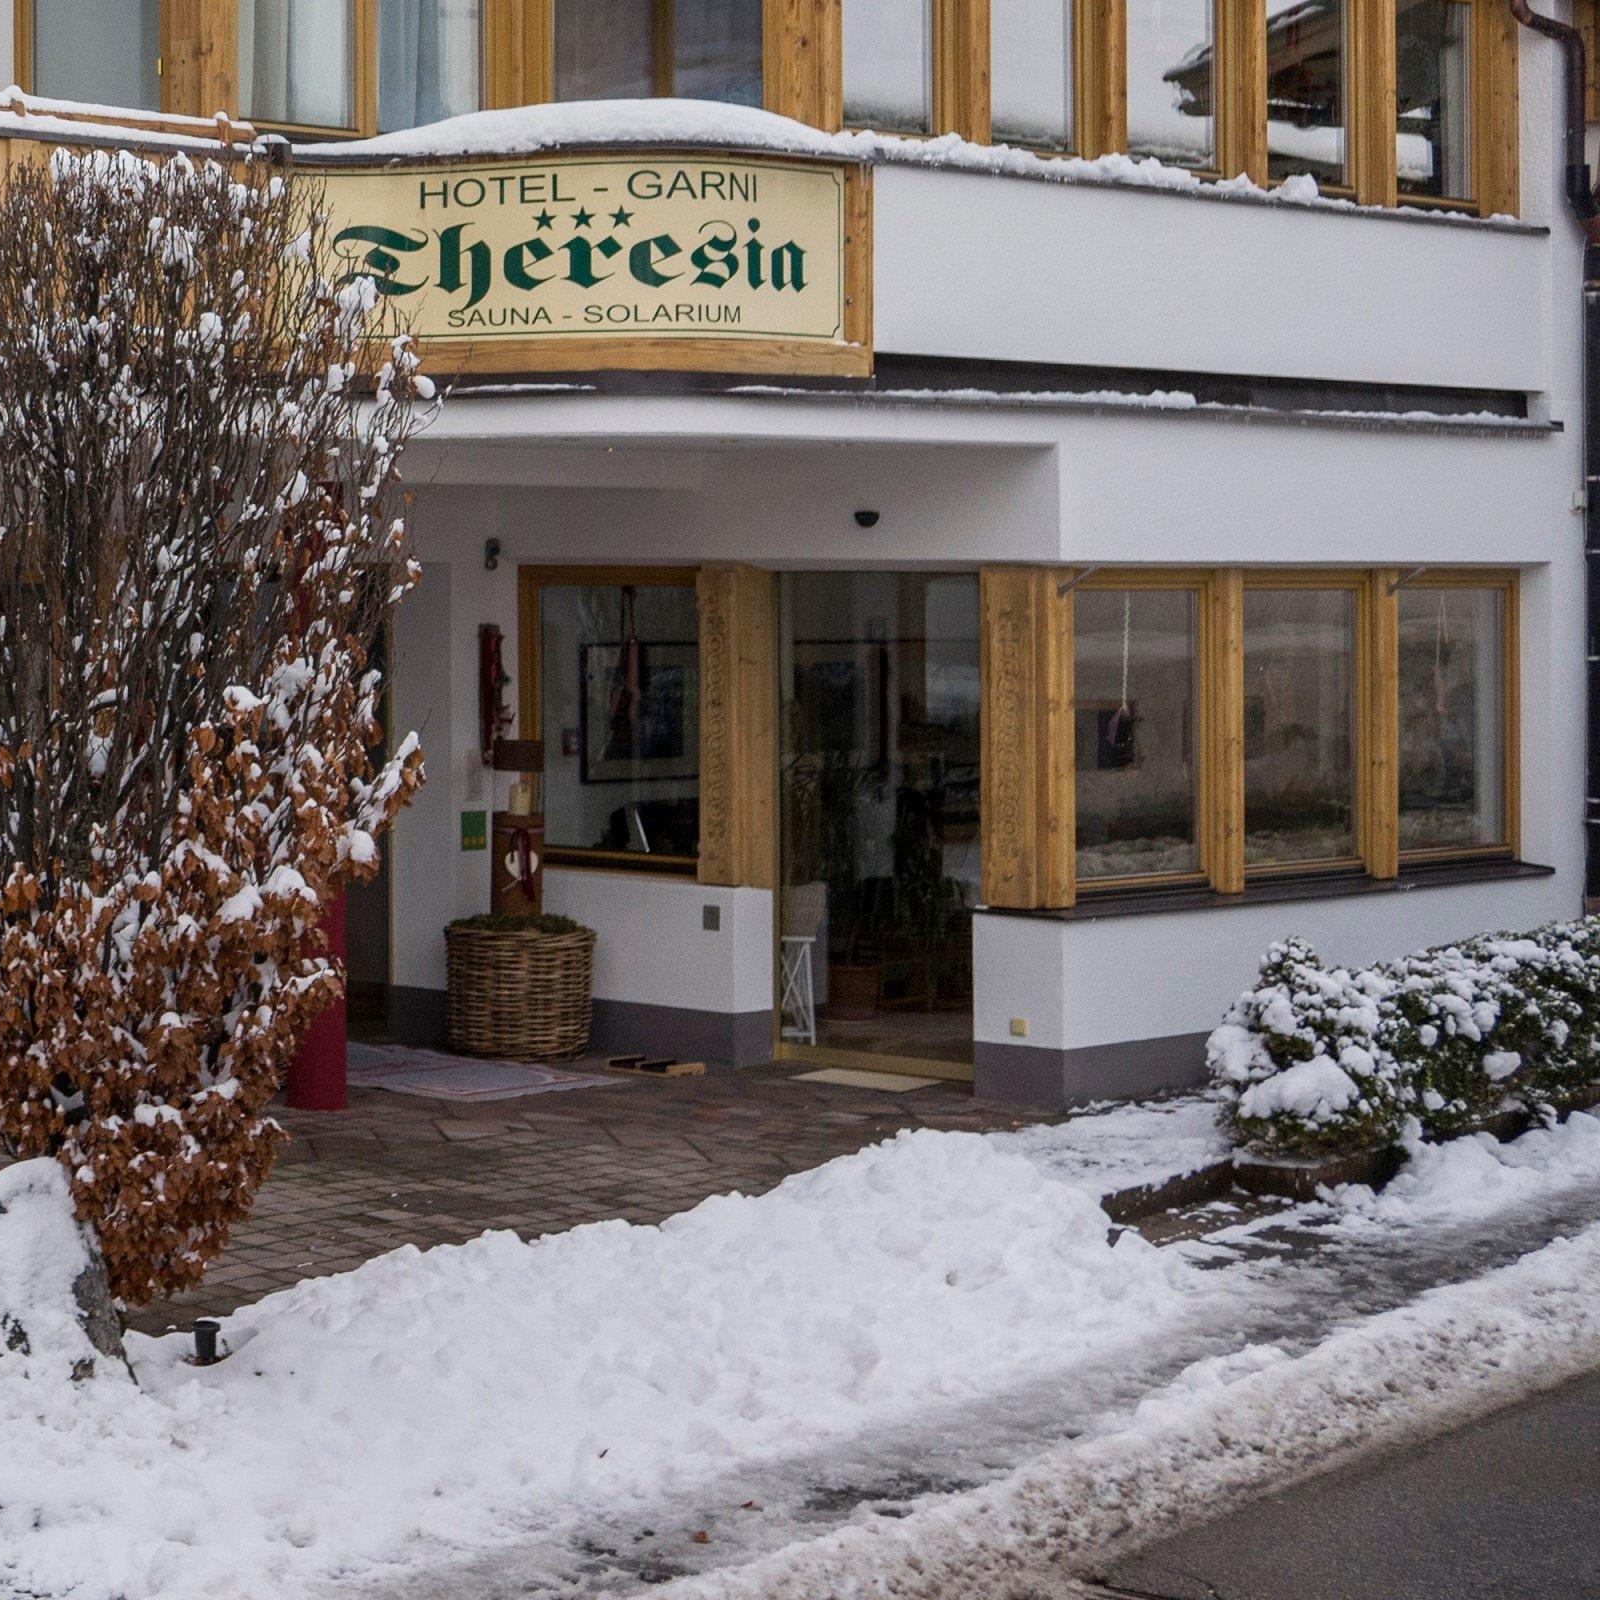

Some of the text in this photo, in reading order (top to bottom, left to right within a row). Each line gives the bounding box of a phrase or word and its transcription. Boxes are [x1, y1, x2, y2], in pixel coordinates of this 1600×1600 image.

[420, 173, 576, 209] HOTEL
[627, 170, 757, 202] GARNI
[332, 217, 809, 312] Theresia
[448, 306, 552, 328] SAUNA
[583, 304, 742, 324] SOLARIUM
